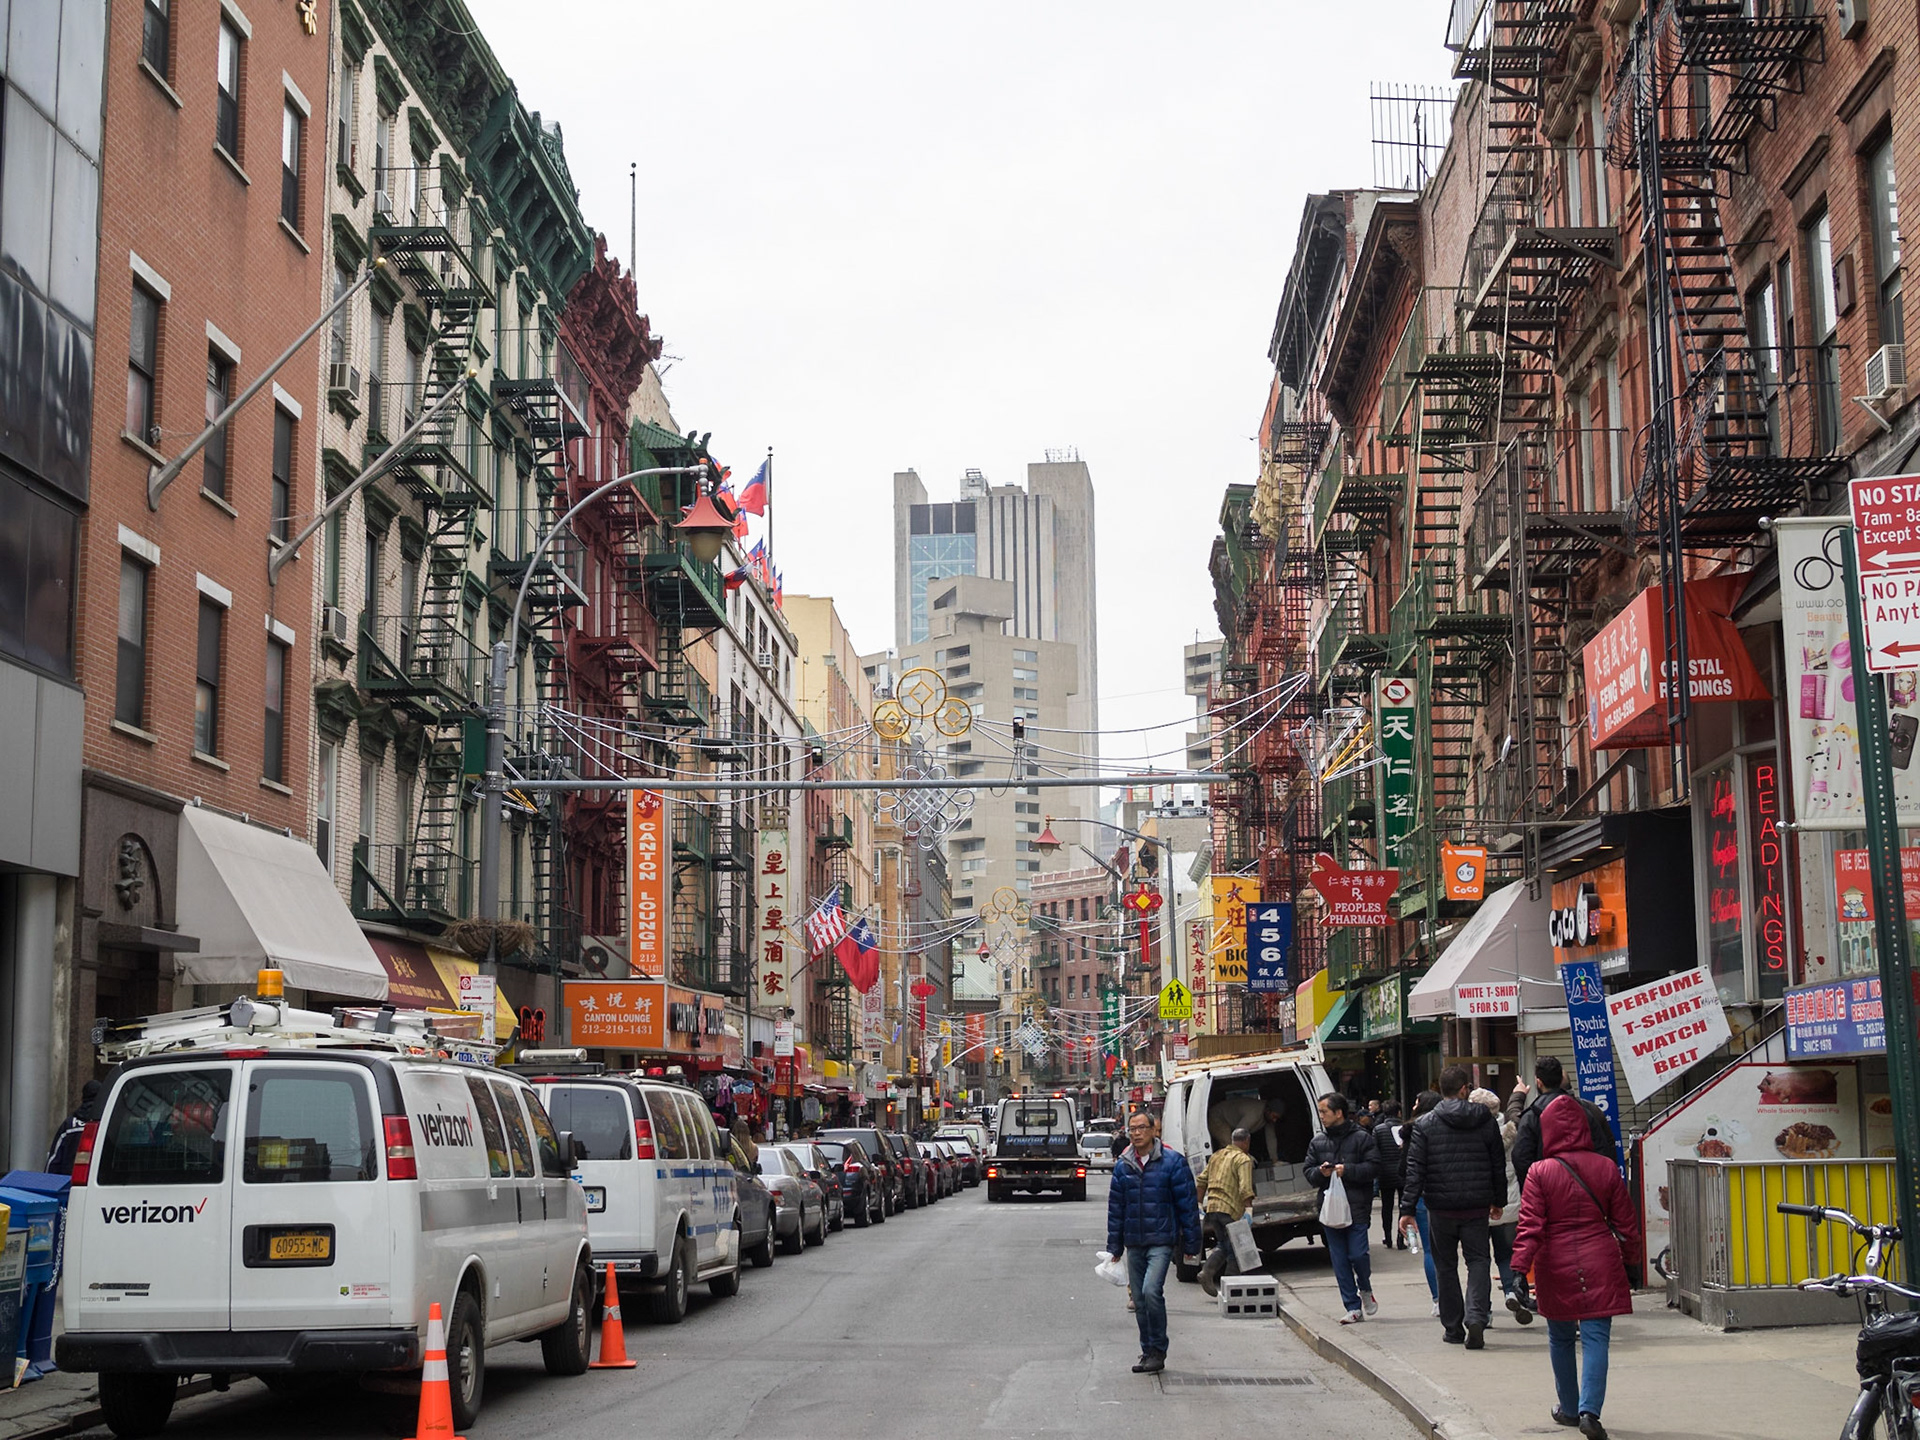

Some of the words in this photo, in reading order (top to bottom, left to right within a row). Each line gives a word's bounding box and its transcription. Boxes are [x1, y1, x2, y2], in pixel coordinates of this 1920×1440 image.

[1859, 487, 1885, 506] NO
[1862, 511, 1892, 526] 7am
[1863, 528, 1911, 544] Except
[1872, 581, 1897, 600] NO
[1807, 612, 1842, 623] Beauty
[1660, 659, 1724, 678] CRSTAL
[1600, 679, 1617, 712] FENG
[1619, 664, 1636, 696] SHUI
[1659, 678, 1733, 698] REDINGS
[638, 823, 656, 880] CANTON
[1757, 766, 1783, 970] READINGS
[1335, 903, 1381, 912] PEOPLES
[638, 892, 656, 950] LOUNGE
[761, 849, 786, 995] 皇上皇酒家
[1329, 915, 1387, 924] PHARMACY
[640, 954, 656, 963] 212
[1458, 987, 1483, 999] WHITE
[1610, 971, 1703, 1016] PERFUME
[1162, 1007, 1190, 1017] AHEAD
[1469, 1003, 1476, 1014] 5
[1476, 1003, 1491, 1013] FOR
[1500, 1001, 1509, 1012] 10
[1622, 996, 1702, 1035] T-SHIRT
[584, 1013, 617, 1023] CANTON
[618, 1013, 650, 1023] LOUNGE
[1573, 1014, 1607, 1033] Psychic
[581, 1024, 653, 1035] 212-219-1431
[1338, 1025, 1358, 1034] 天仁
[1577, 1035, 1607, 1049] Reader
[1632, 1020, 1708, 1057] WATCH
[1803, 1040, 1819, 1053] SINCE
[1590, 1050, 1598, 1058] &
[1653, 1047, 1698, 1075] BELT
[1579, 1059, 1612, 1075] Advisor
[1582, 1083, 1613, 1092] Readings
[1585, 1076, 1609, 1085] Special
[1778, 1107, 1807, 1115] Suckling
[1829, 1107, 1840, 1115] Pig
[417, 1103, 473, 1147] verizon
[101, 1200, 195, 1223] verizon
